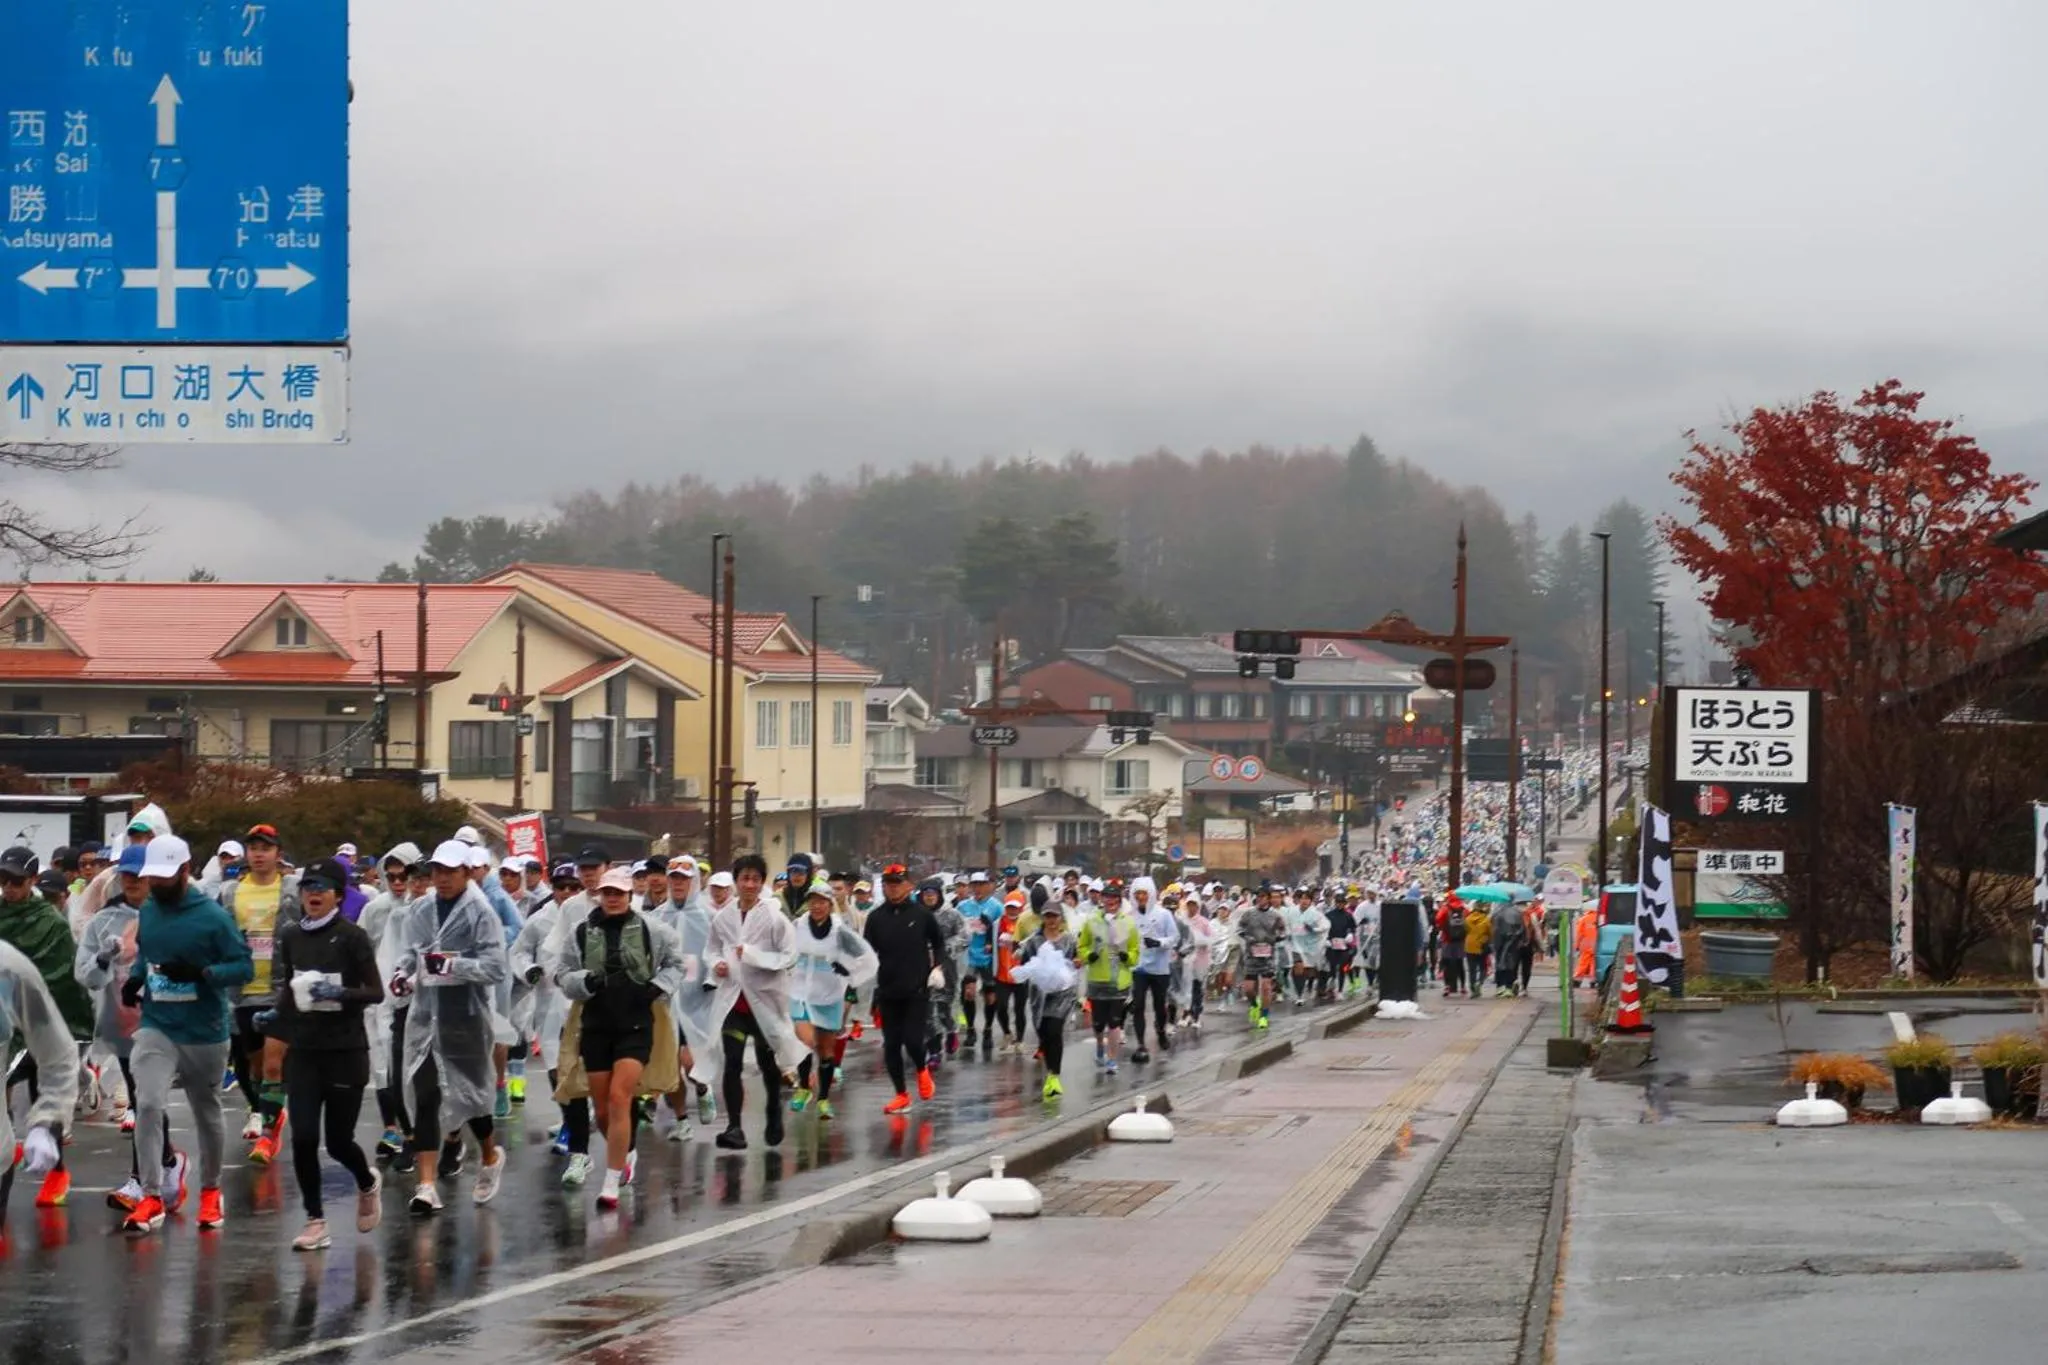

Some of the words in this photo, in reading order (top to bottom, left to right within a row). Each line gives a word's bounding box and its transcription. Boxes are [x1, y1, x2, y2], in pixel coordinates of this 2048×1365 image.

[85, 47, 132, 66] Kfu
[55, 152, 88, 172] Sai
[65, 363, 319, 400] 河口湖大橋
[1691, 699, 1794, 729] ほうとう
[1691, 740, 1793, 766] 天ぷら
[1704, 853, 1777, 870] 準備中
